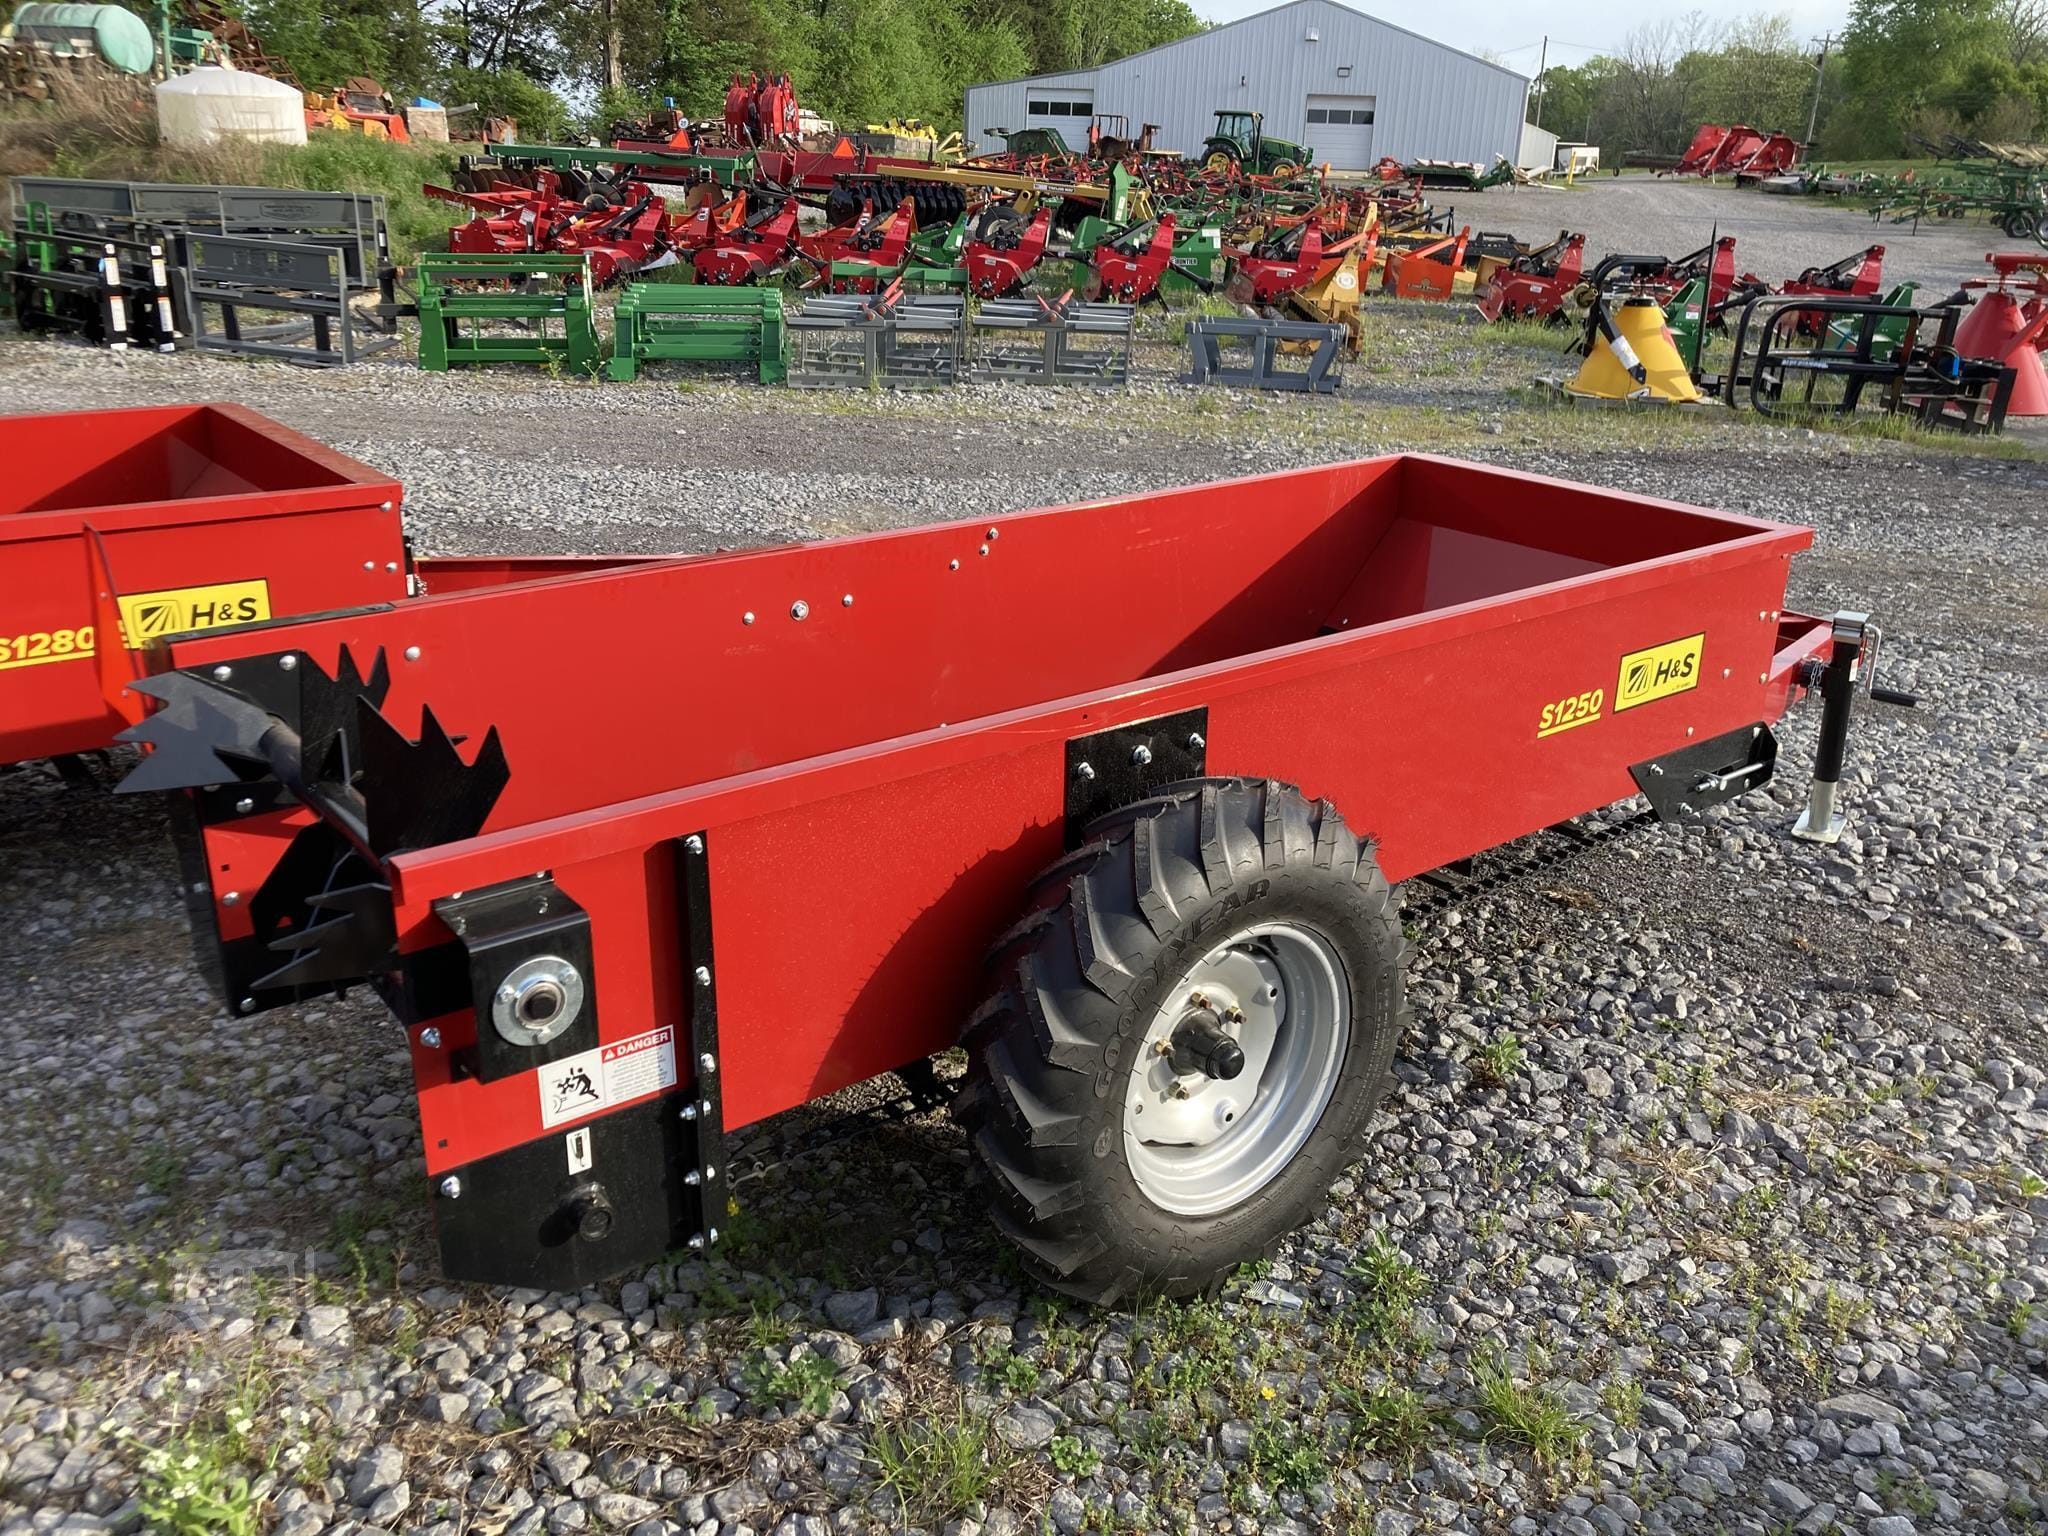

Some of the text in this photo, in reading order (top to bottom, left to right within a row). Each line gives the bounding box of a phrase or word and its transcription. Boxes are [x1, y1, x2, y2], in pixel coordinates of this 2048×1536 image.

[190, 597, 257, 628] H&S
[1653, 652, 1695, 687] H&S
[1538, 688, 1604, 730] S1250
[616, 1031, 669, 1057] DANGER
